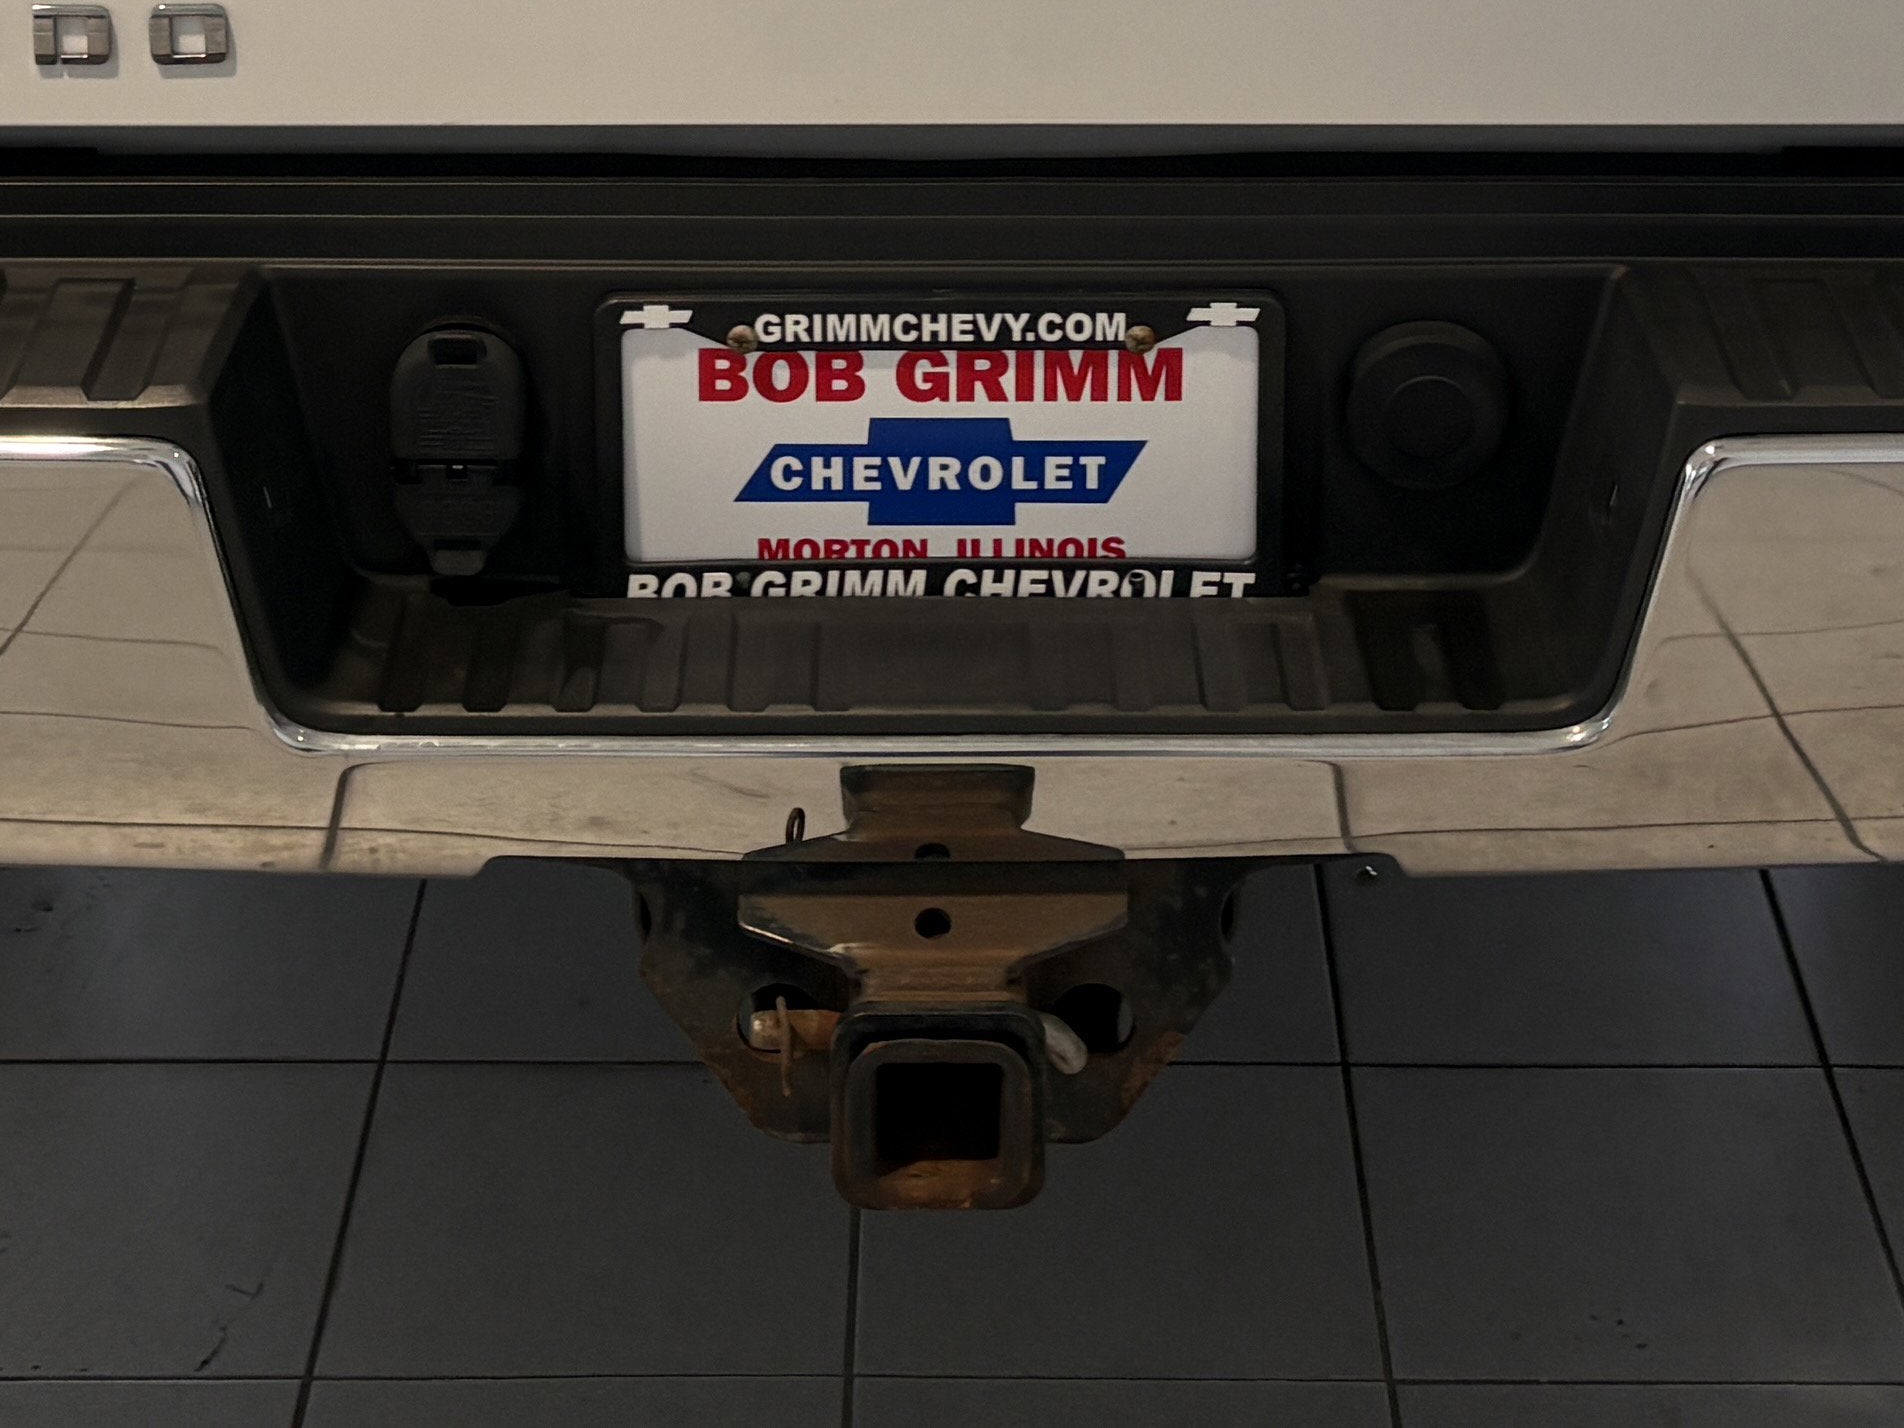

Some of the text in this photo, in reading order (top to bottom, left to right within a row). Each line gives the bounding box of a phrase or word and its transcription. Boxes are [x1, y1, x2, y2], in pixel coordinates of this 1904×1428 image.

[754, 312, 1128, 343] GRIMMCHEVY.COM
[698, 348, 1183, 403] BOB GRIMM
[770, 456, 1106, 491] CHEVROLET
[627, 572, 733, 598] BOB
[750, 570, 927, 597] GRIMM
